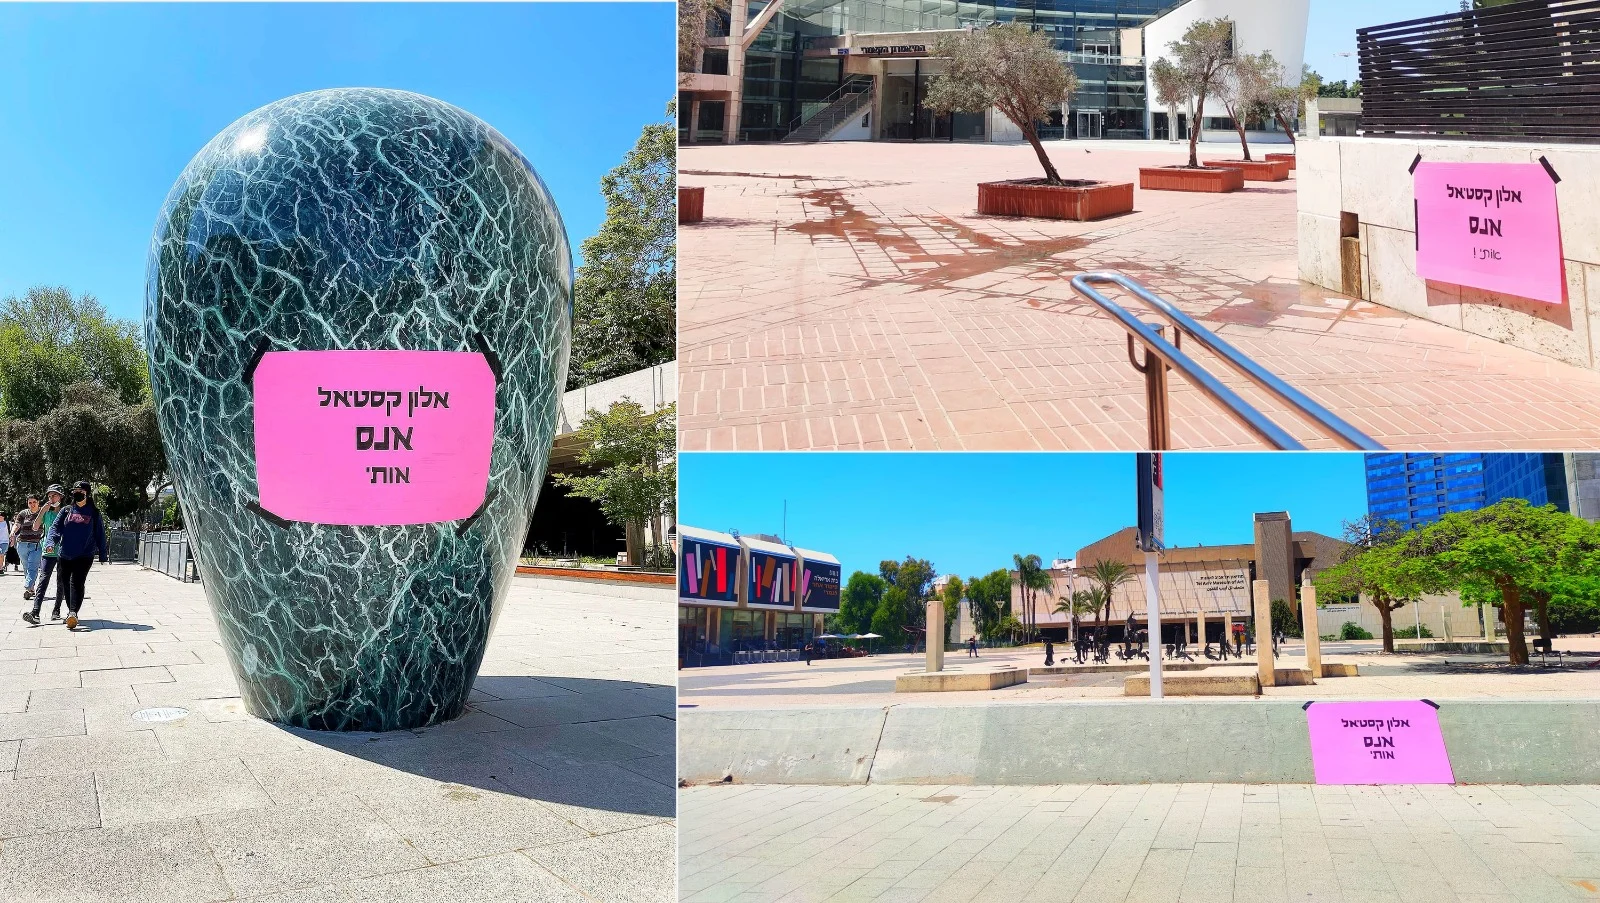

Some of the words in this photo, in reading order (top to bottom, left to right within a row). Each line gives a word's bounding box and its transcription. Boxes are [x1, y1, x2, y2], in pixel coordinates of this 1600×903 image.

[1495, 185, 1523, 209] אלון
[1468, 215, 1503, 238] אנס
[408, 385, 450, 418] אלון
[355, 426, 414, 451] אנס
[365, 466, 411, 484] אותי
[1386, 716, 1411, 732] אלון
[1363, 736, 1396, 748] אנס
[1369, 750, 1396, 760] אותי
